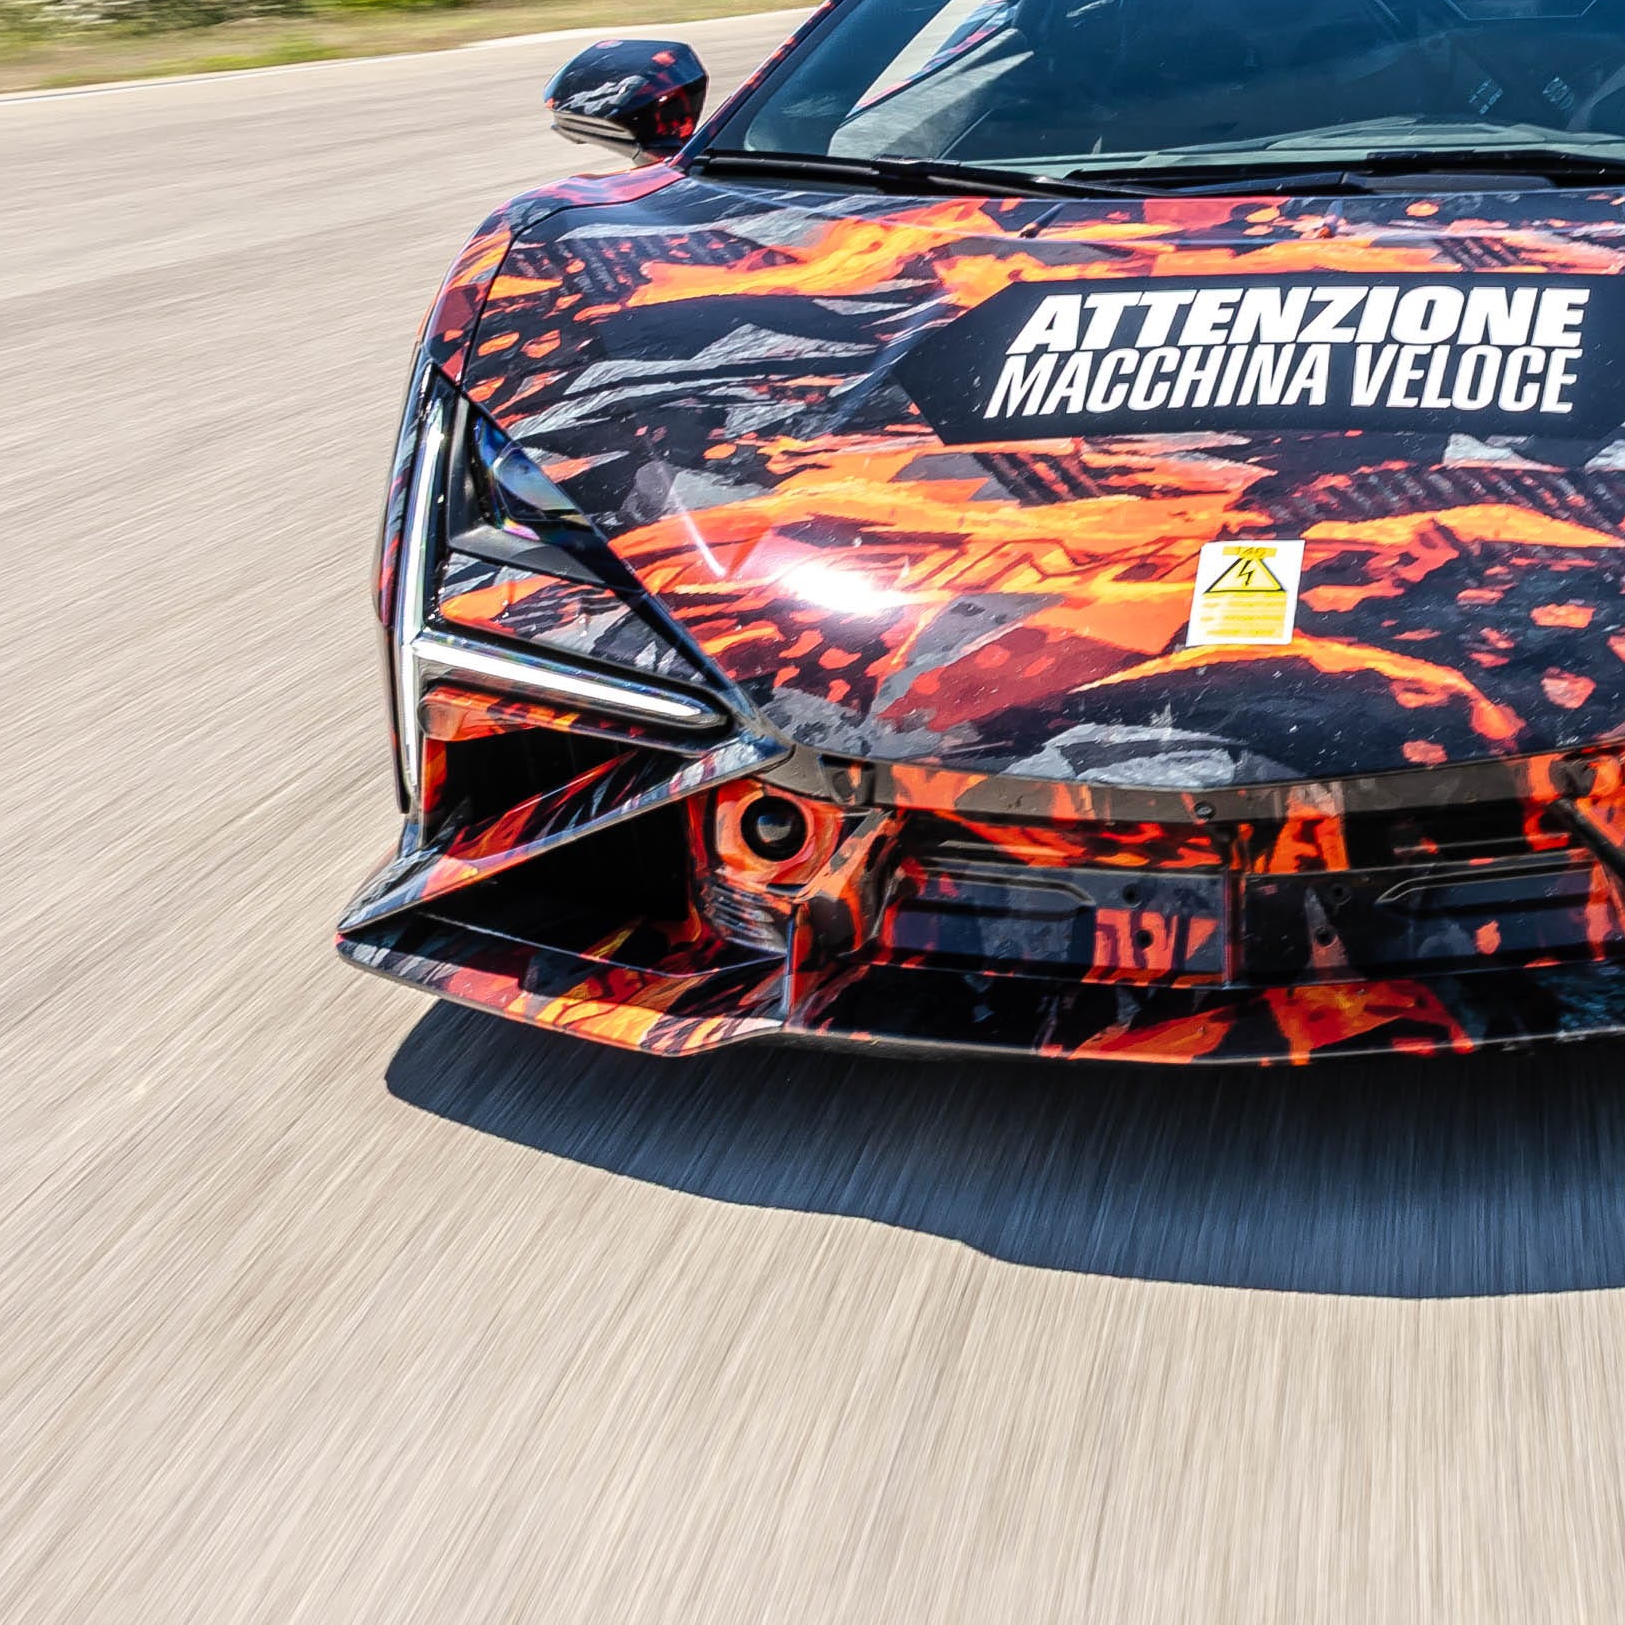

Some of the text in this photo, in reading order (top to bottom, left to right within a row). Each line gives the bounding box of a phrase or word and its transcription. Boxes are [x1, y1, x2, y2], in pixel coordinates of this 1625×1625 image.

[1005, 286, 1591, 355] ATTENZIONE
[982, 344, 1583, 419] MACCHINA VELOCE
